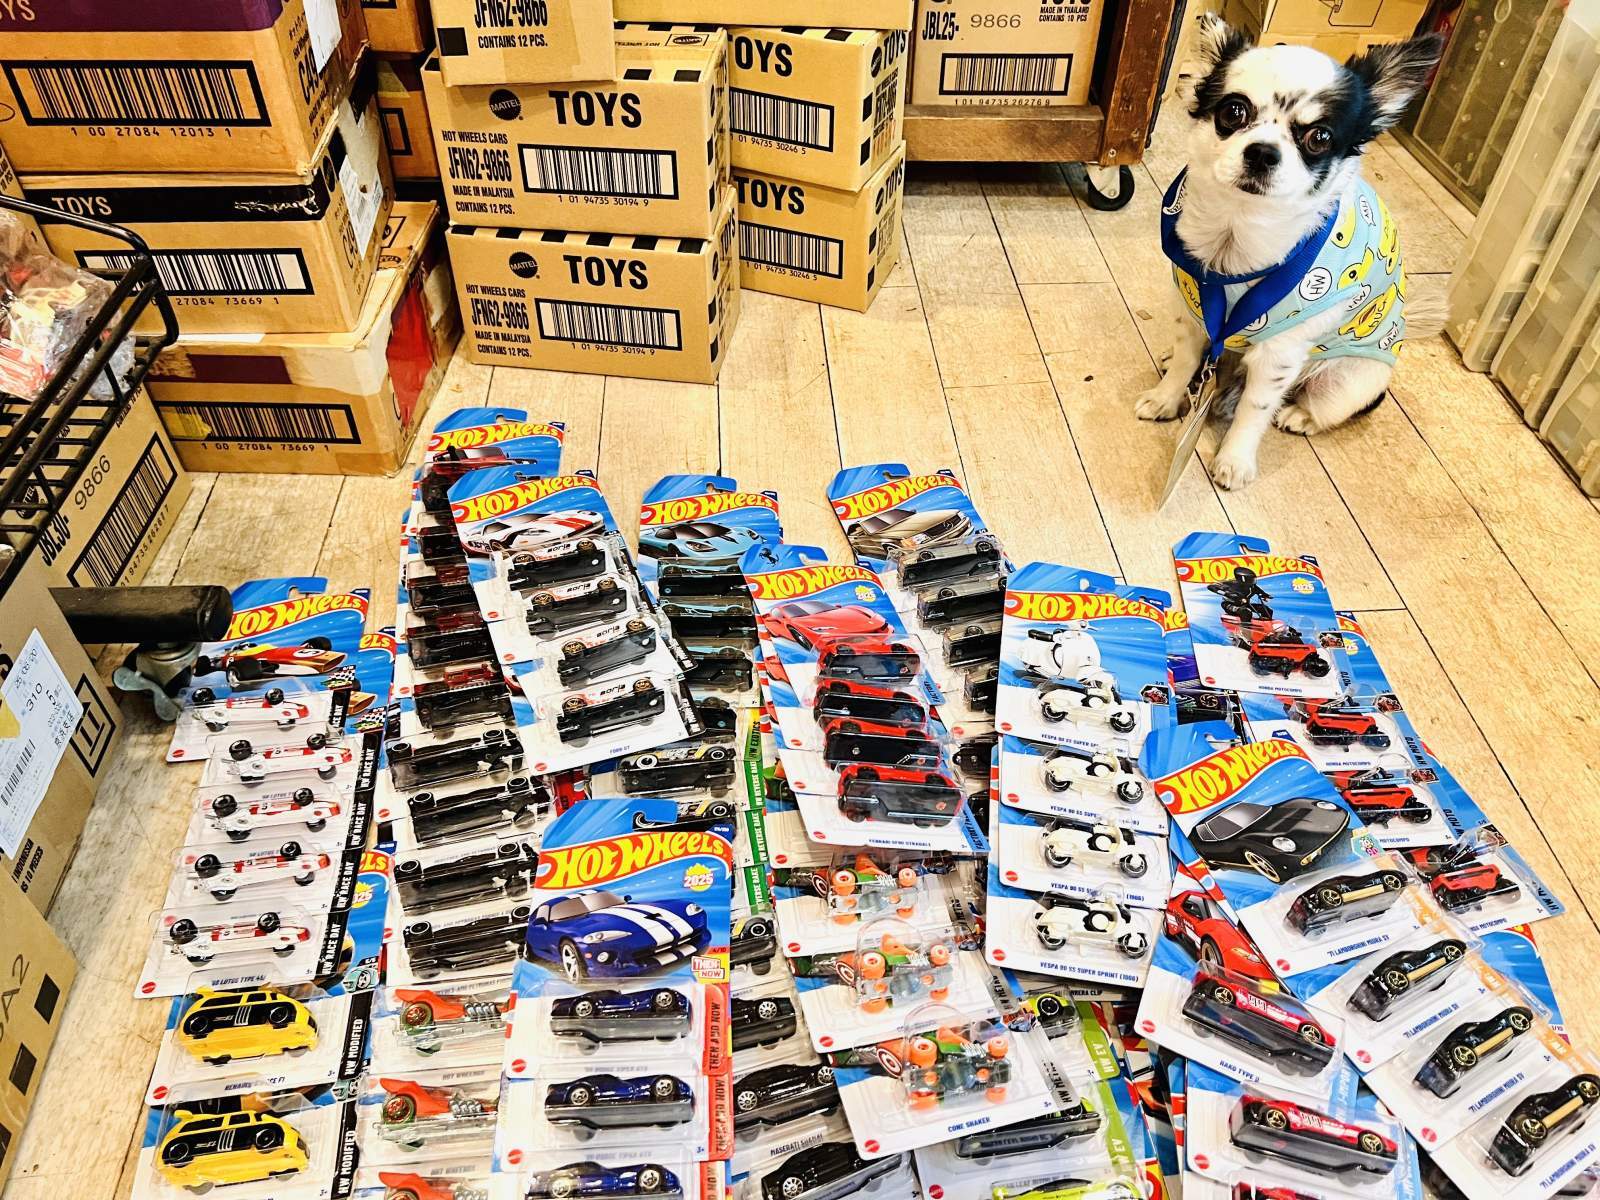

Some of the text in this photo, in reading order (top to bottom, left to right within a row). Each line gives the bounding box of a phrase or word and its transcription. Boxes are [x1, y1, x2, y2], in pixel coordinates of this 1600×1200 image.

[970, 14, 1022, 29] 9866
[478, 36, 516, 49] CONTAINS
[518, 36, 528, 47] 12
[728, 34, 793, 77] OYS
[548, 90, 642, 128] TOYS
[88, 127, 106, 137] 00
[116, 127, 160, 137] 27084
[171, 127, 214, 137] 12013
[442, 130, 508, 144] HOT WHEELS CARS
[448, 147, 512, 182] JFN62-9866
[453, 185, 472, 196] MADE
[482, 187, 515, 198] MALAYSIA
[456, 201, 488, 213] CONTAINS
[490, 204, 498, 213] 12
[568, 196, 579, 204] 01
[584, 196, 609, 205] 94735
[613, 197, 639, 206] 30194
[563, 254, 648, 290] TOYS
[466, 284, 526, 298] HOT WHEELS CARS
[177, 297, 215, 306] 27084
[224, 297, 263, 306] 73669
[471, 298, 529, 330] JFN62-9866
[475, 331, 492, 340] MADE
[238, 443, 273, 451] 27084
[281, 444, 316, 452] 73669
[75, 455, 111, 511] 9866
[683, 872, 714, 888] 2025
[329, 923, 341, 940] DAY
[325, 940, 337, 963] RACE
[347, 1018, 364, 1060] MODIFIED
[948, 1117, 991, 1133] CONE SHAKER
[341, 1130, 356, 1177] MODIFIED
